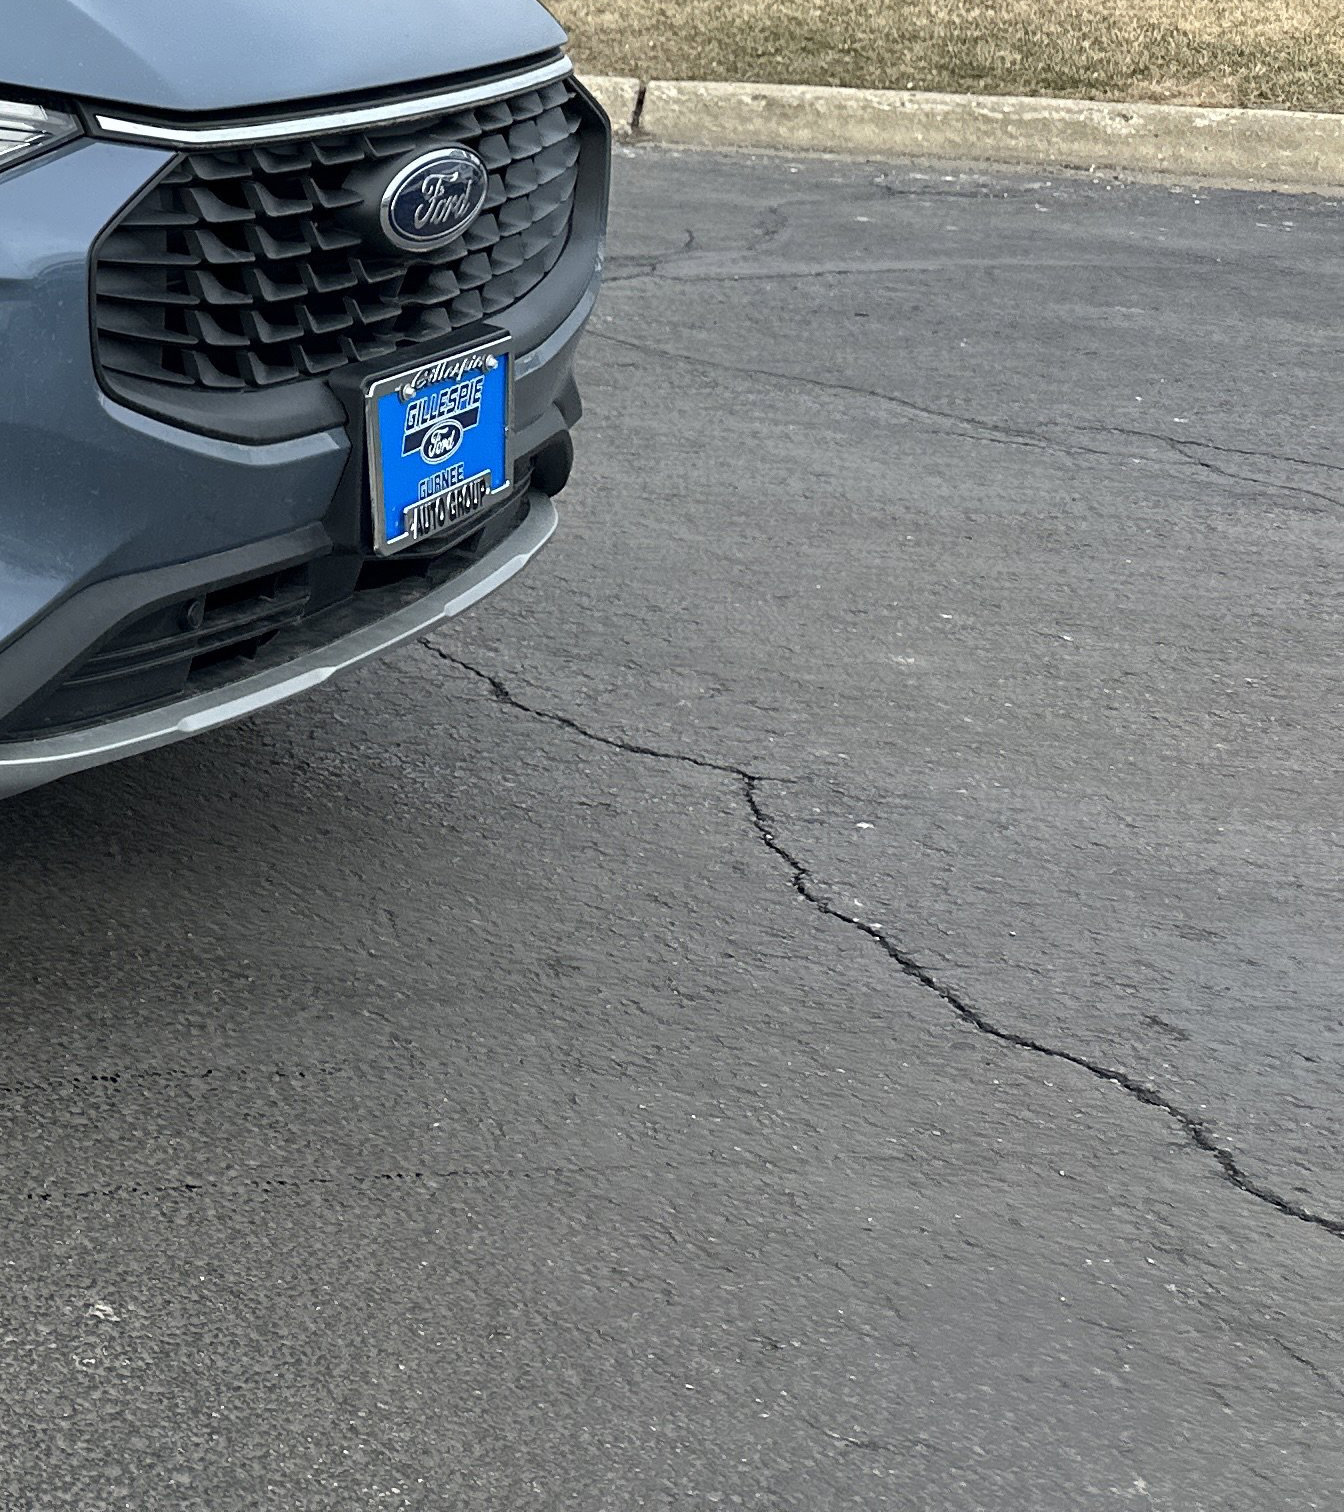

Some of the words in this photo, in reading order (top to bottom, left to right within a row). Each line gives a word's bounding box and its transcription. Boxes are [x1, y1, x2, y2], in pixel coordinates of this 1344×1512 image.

[414, 172, 472, 229] Ford
[405, 376, 485, 431] GILLESPIE
[428, 427, 456, 458] Ford
[411, 497, 446, 539] AUTO
[447, 478, 487, 520] GROUP
[418, 462, 465, 500] GURNEE
